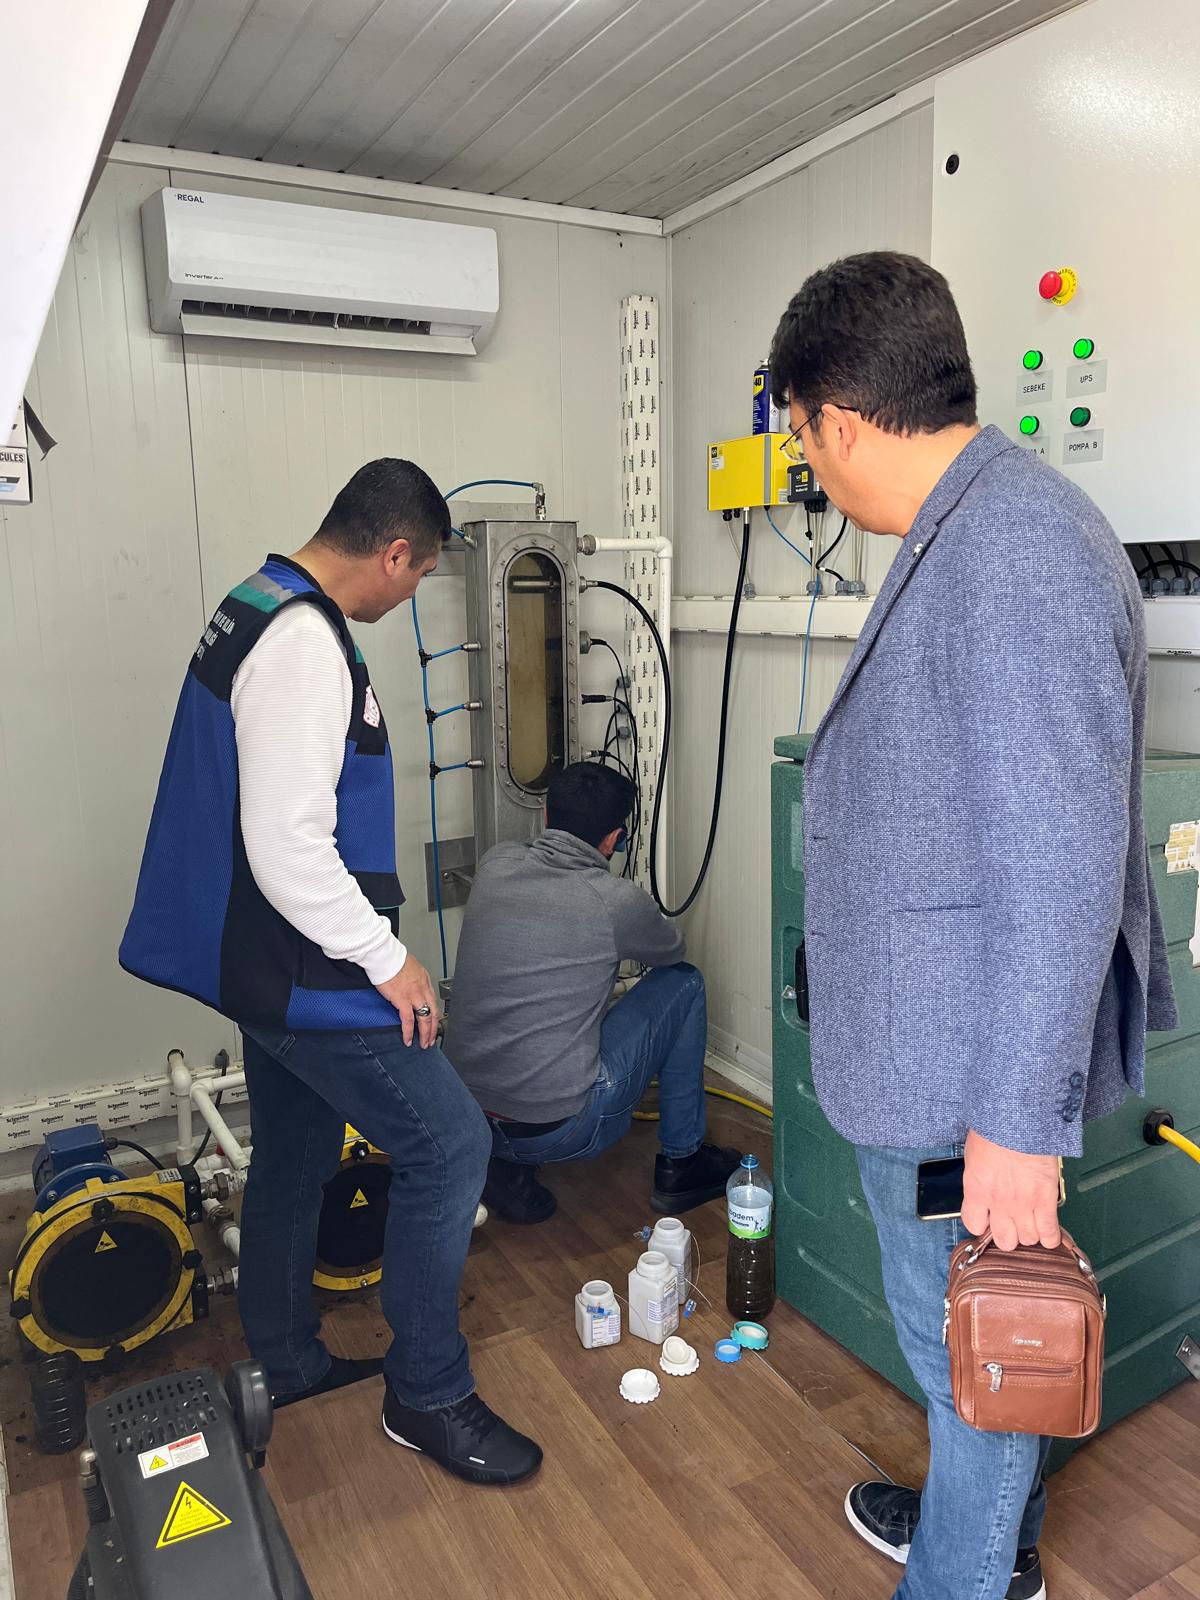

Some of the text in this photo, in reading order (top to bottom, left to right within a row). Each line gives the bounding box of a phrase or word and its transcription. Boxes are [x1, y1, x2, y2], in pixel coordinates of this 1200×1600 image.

[177, 194, 205, 203] REGAL
[1080, 375, 1093, 384] UPS
[1069, 443, 1090, 452] POMPA
